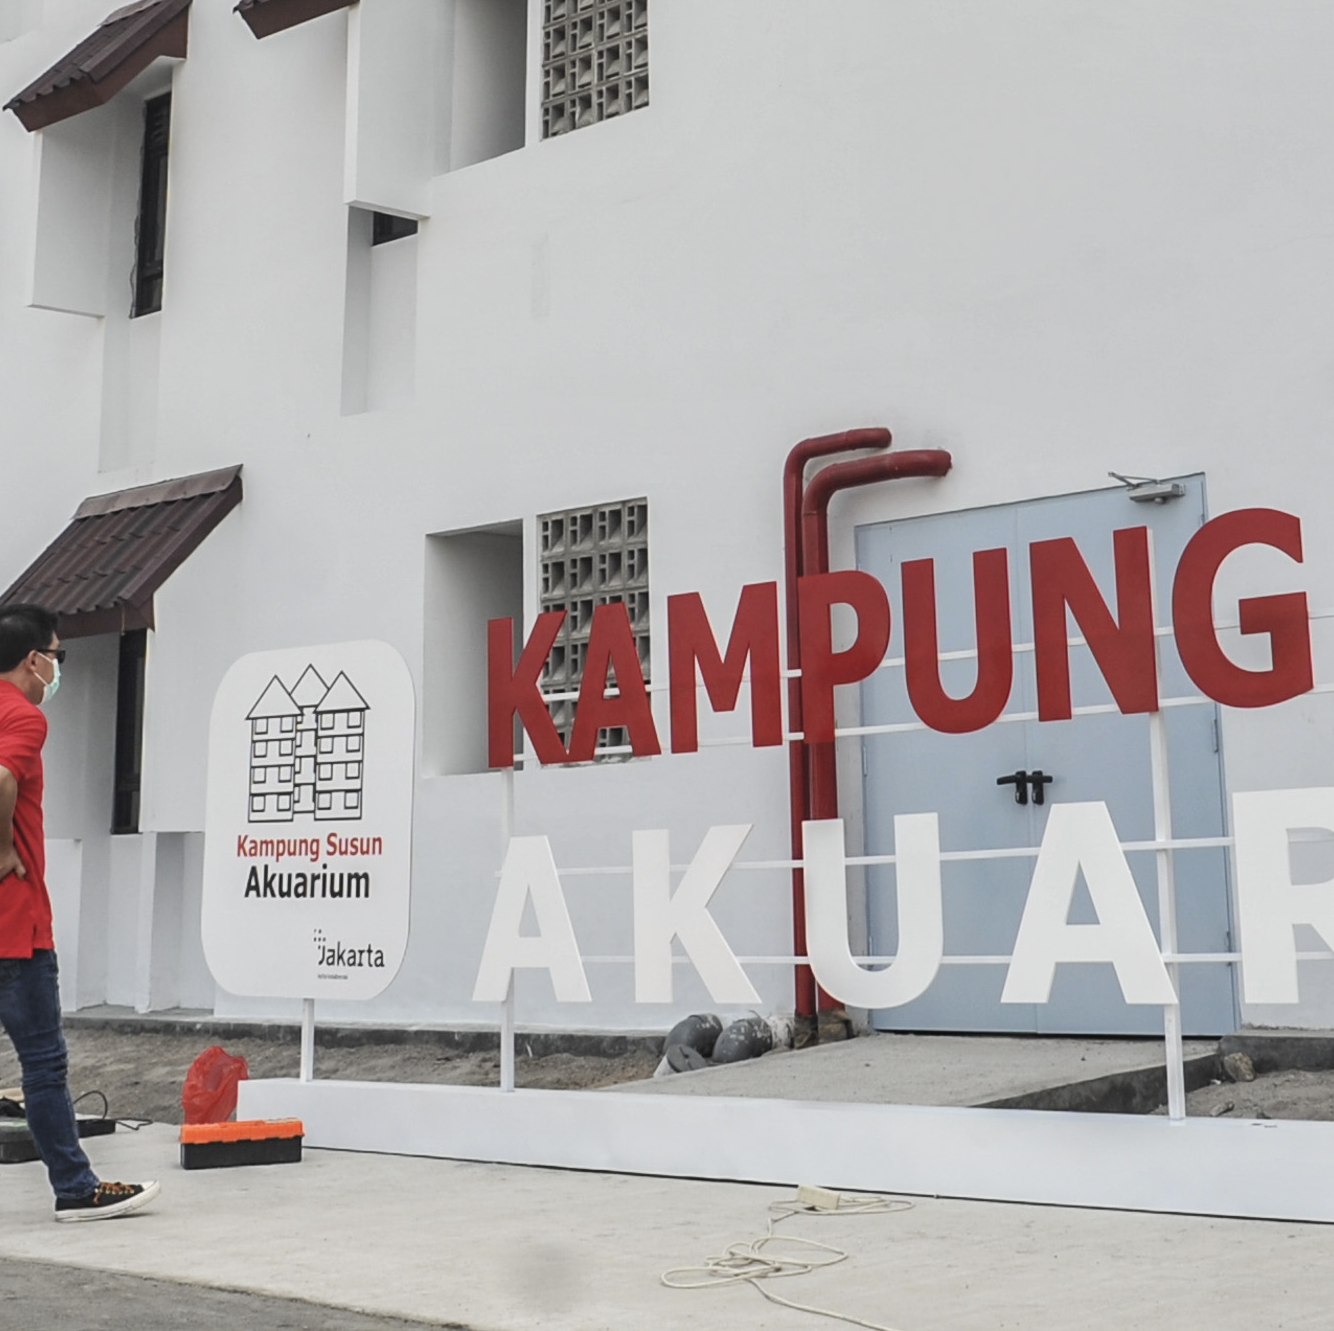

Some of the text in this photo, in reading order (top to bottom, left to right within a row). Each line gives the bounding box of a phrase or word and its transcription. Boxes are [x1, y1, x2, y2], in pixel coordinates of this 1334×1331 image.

[486, 507, 1315, 769] KAMPUNG
[237, 832, 383, 862] Kampung Susun
[244, 863, 370, 899] Akuarium
[317, 941, 385, 968] Jakarta
